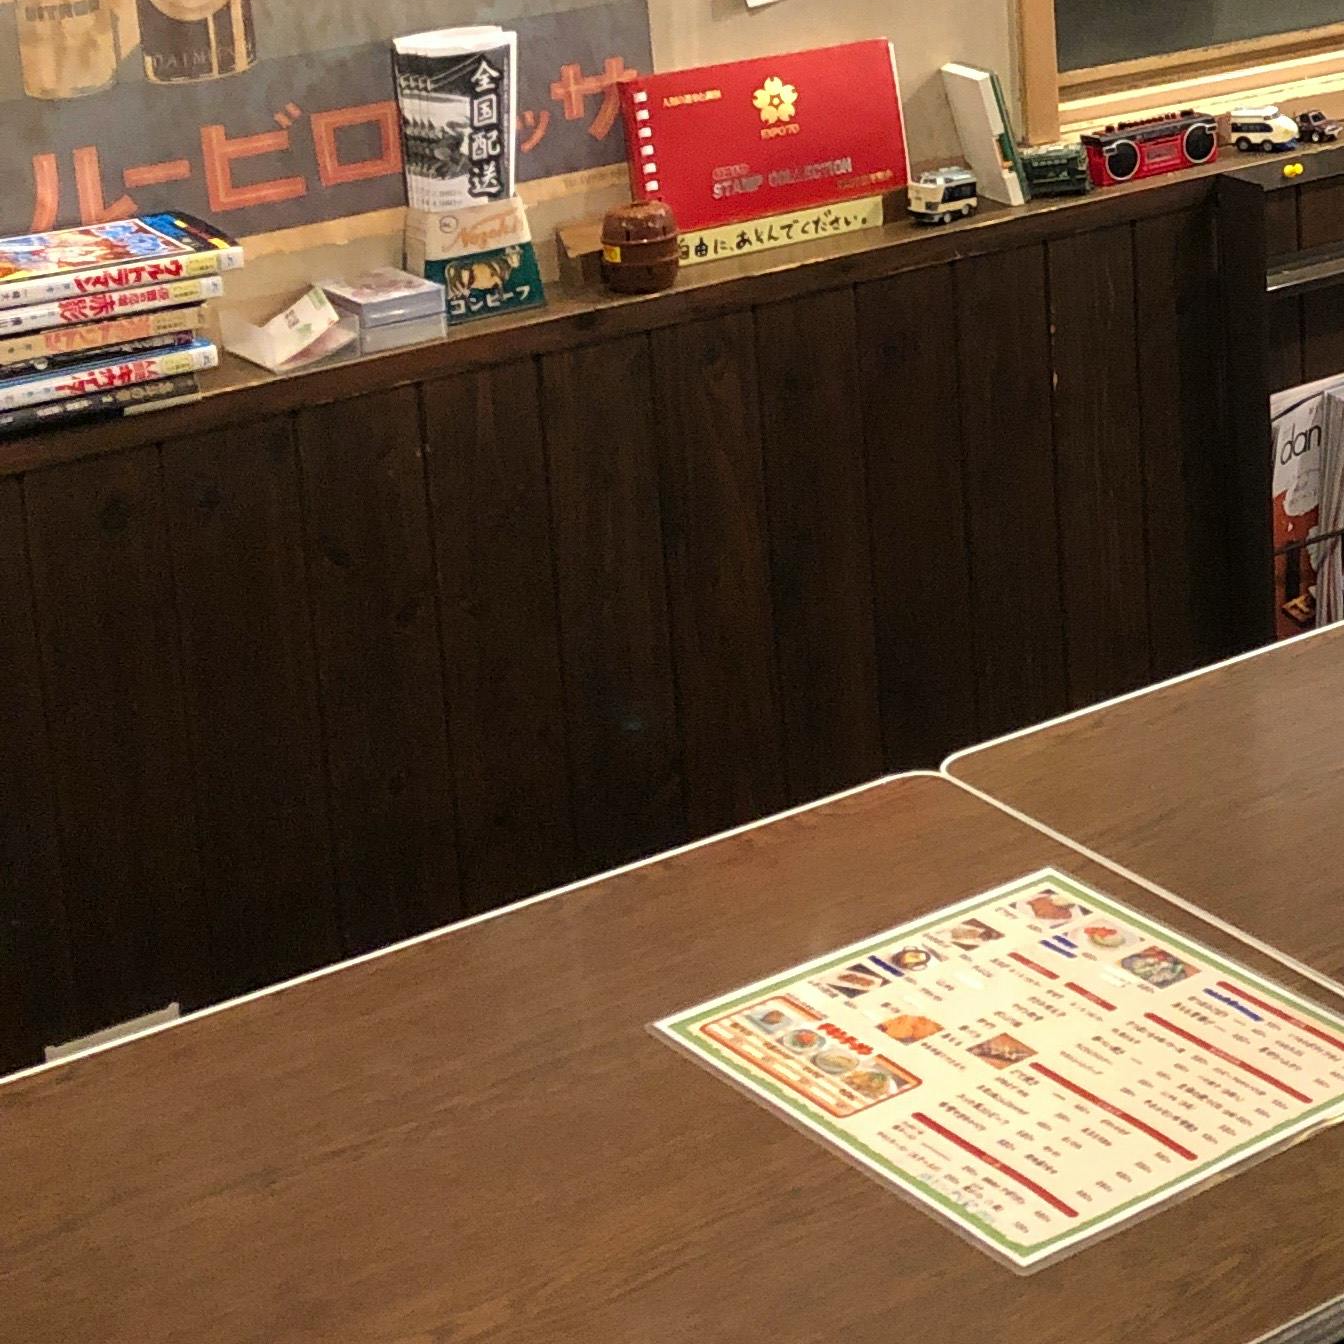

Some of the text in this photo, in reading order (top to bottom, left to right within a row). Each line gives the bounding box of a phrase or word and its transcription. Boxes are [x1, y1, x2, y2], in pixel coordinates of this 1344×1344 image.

[470, 59, 502, 194] 全国配送
[449, 284, 531, 314] コンビーフ
[1280, 423, 1322, 465] dan
